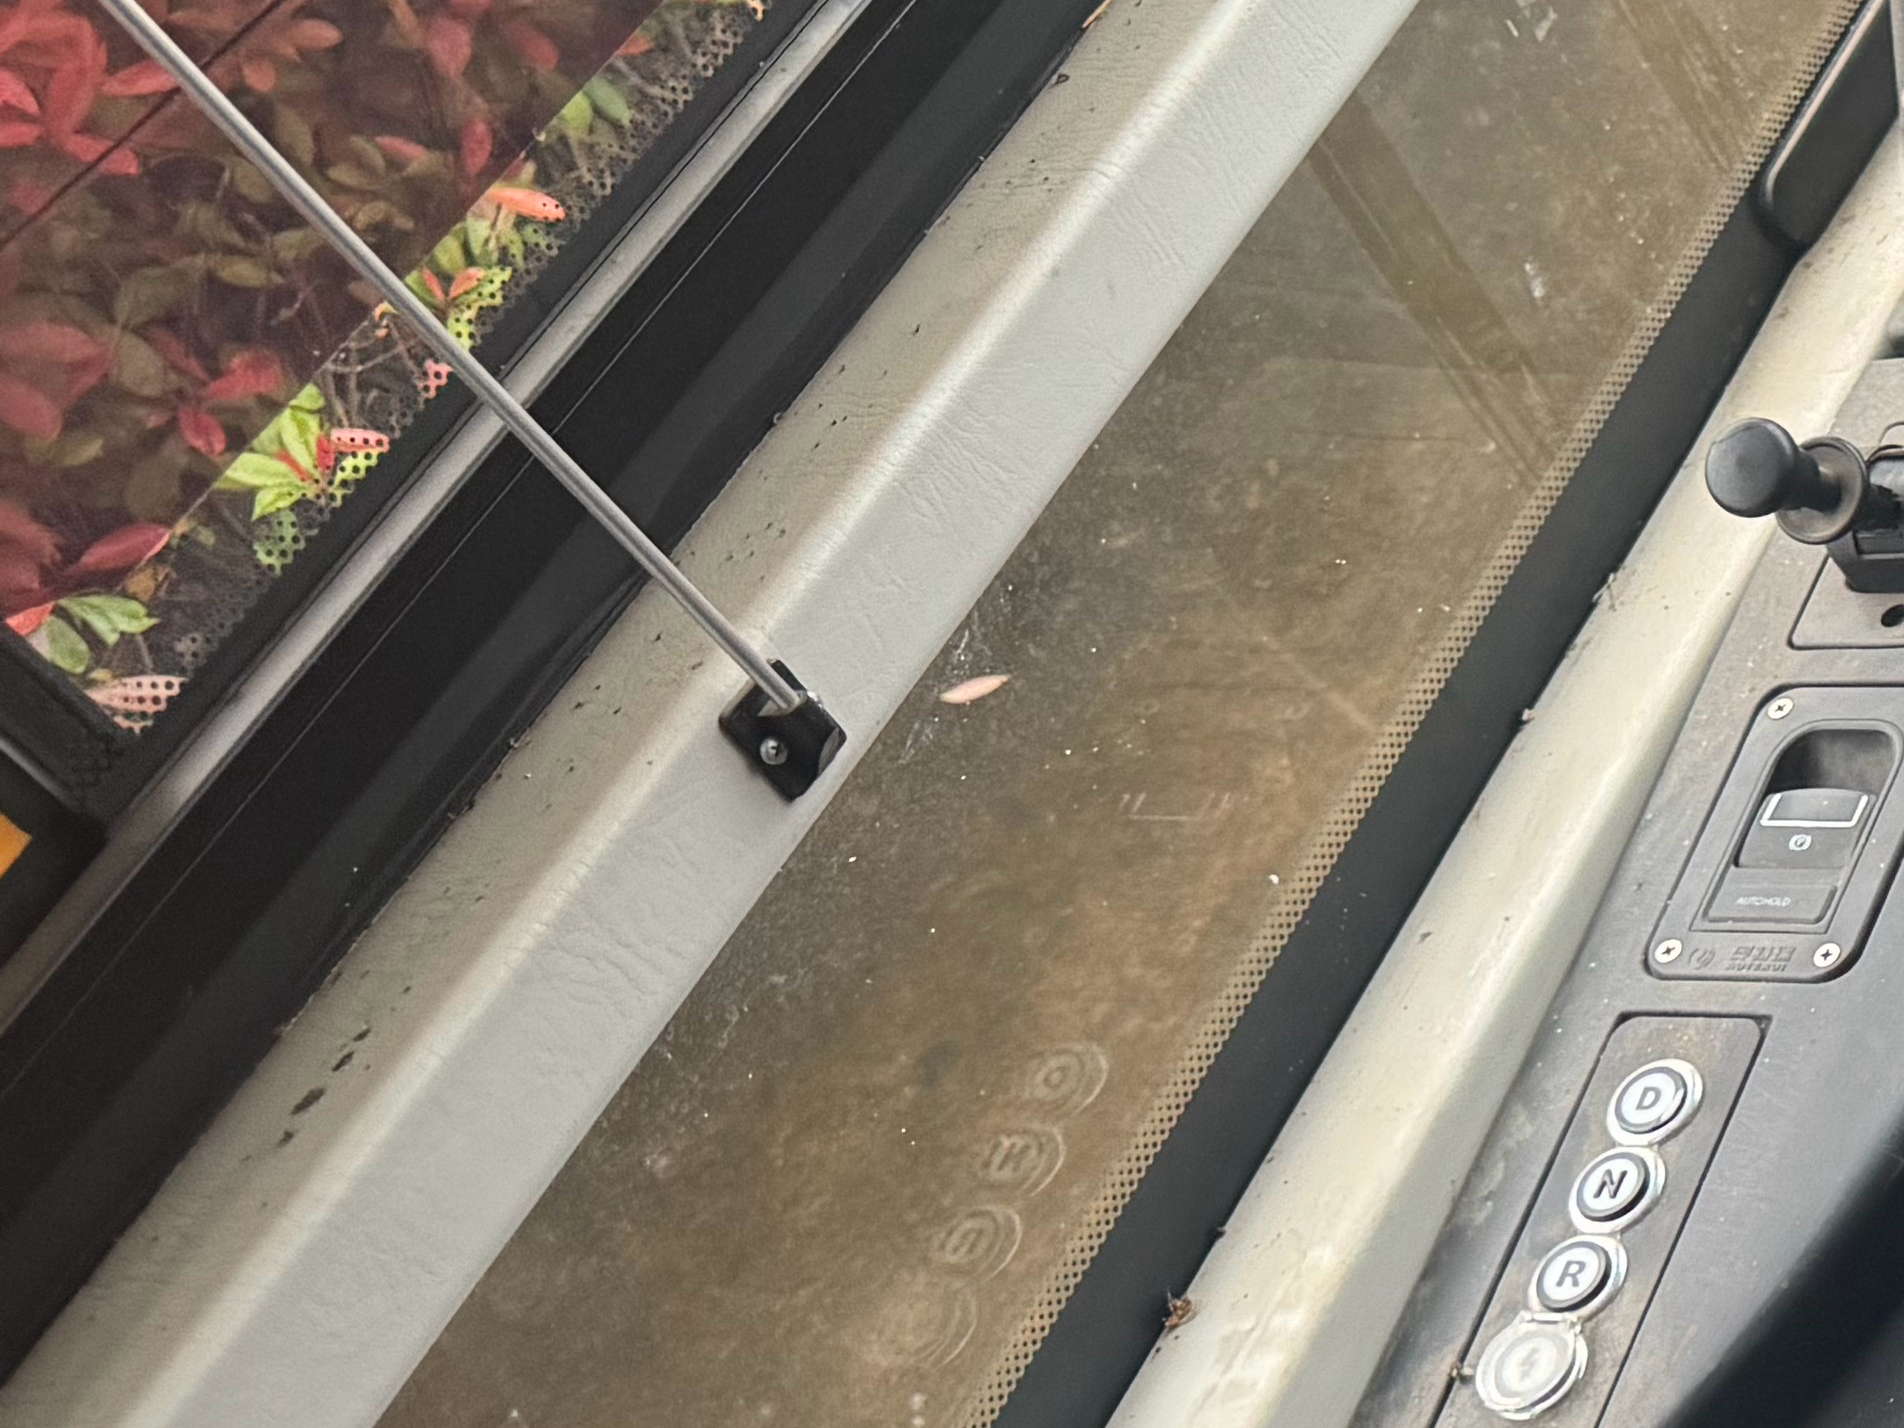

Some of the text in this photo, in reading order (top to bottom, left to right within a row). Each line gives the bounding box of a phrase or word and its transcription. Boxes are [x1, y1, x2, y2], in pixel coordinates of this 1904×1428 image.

[1636, 1086, 1661, 1112] D
[1595, 1170, 1628, 1198] N
[1557, 1260, 1586, 1288] R
